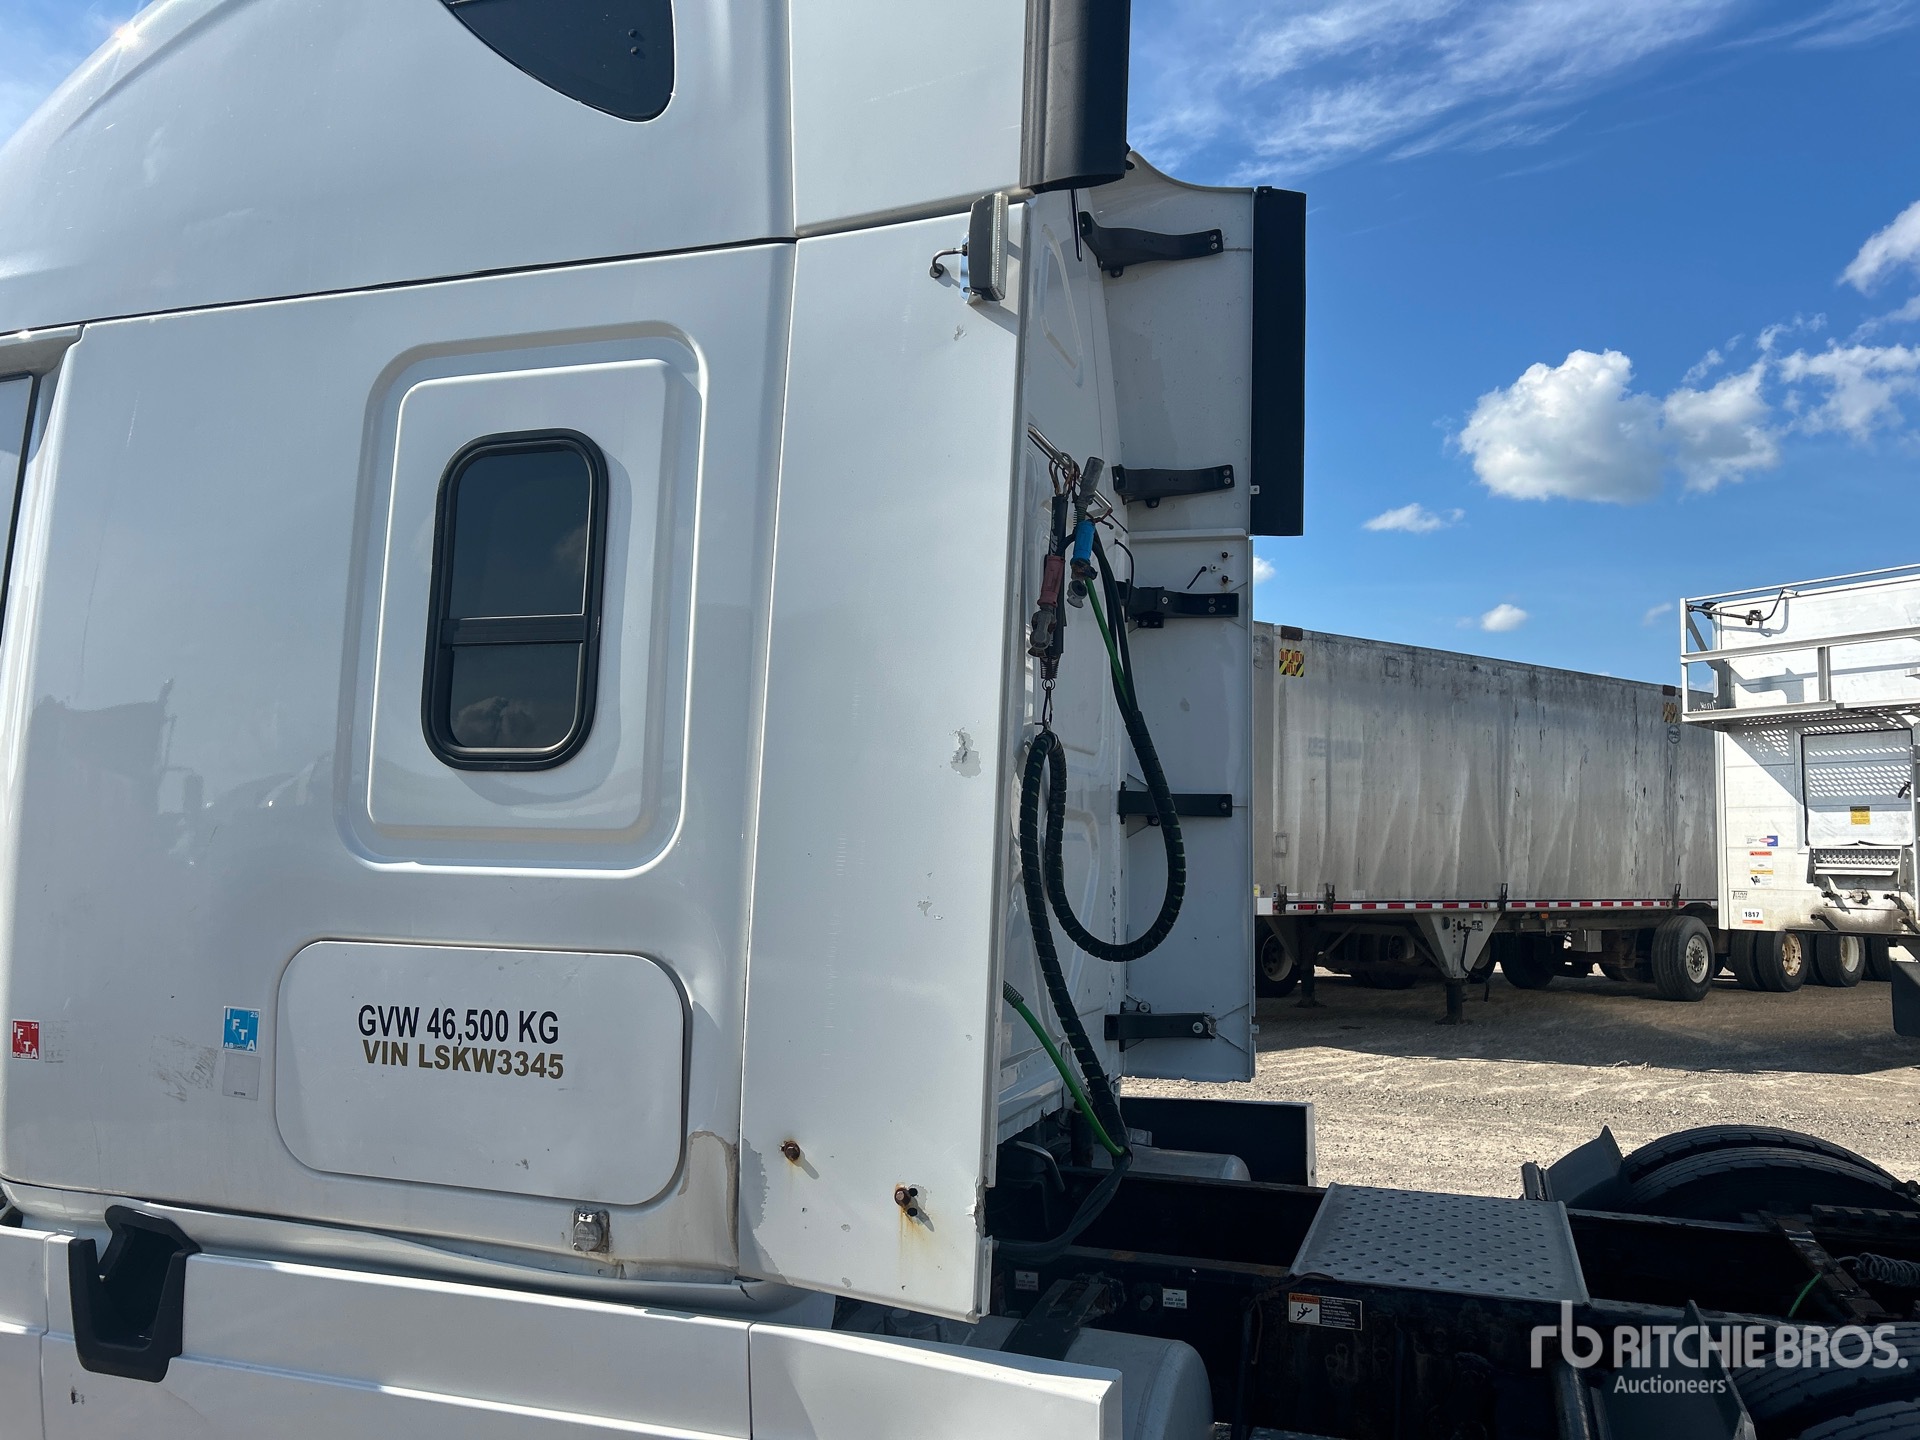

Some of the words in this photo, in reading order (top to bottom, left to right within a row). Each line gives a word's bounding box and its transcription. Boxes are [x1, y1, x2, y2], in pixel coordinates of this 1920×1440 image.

[358, 1004, 420, 1038] GVW
[426, 1007, 509, 1046] 46,500
[518, 1010, 559, 1044] KG
[362, 1039, 409, 1067] VIN
[418, 1043, 564, 1080] LSKW3345
